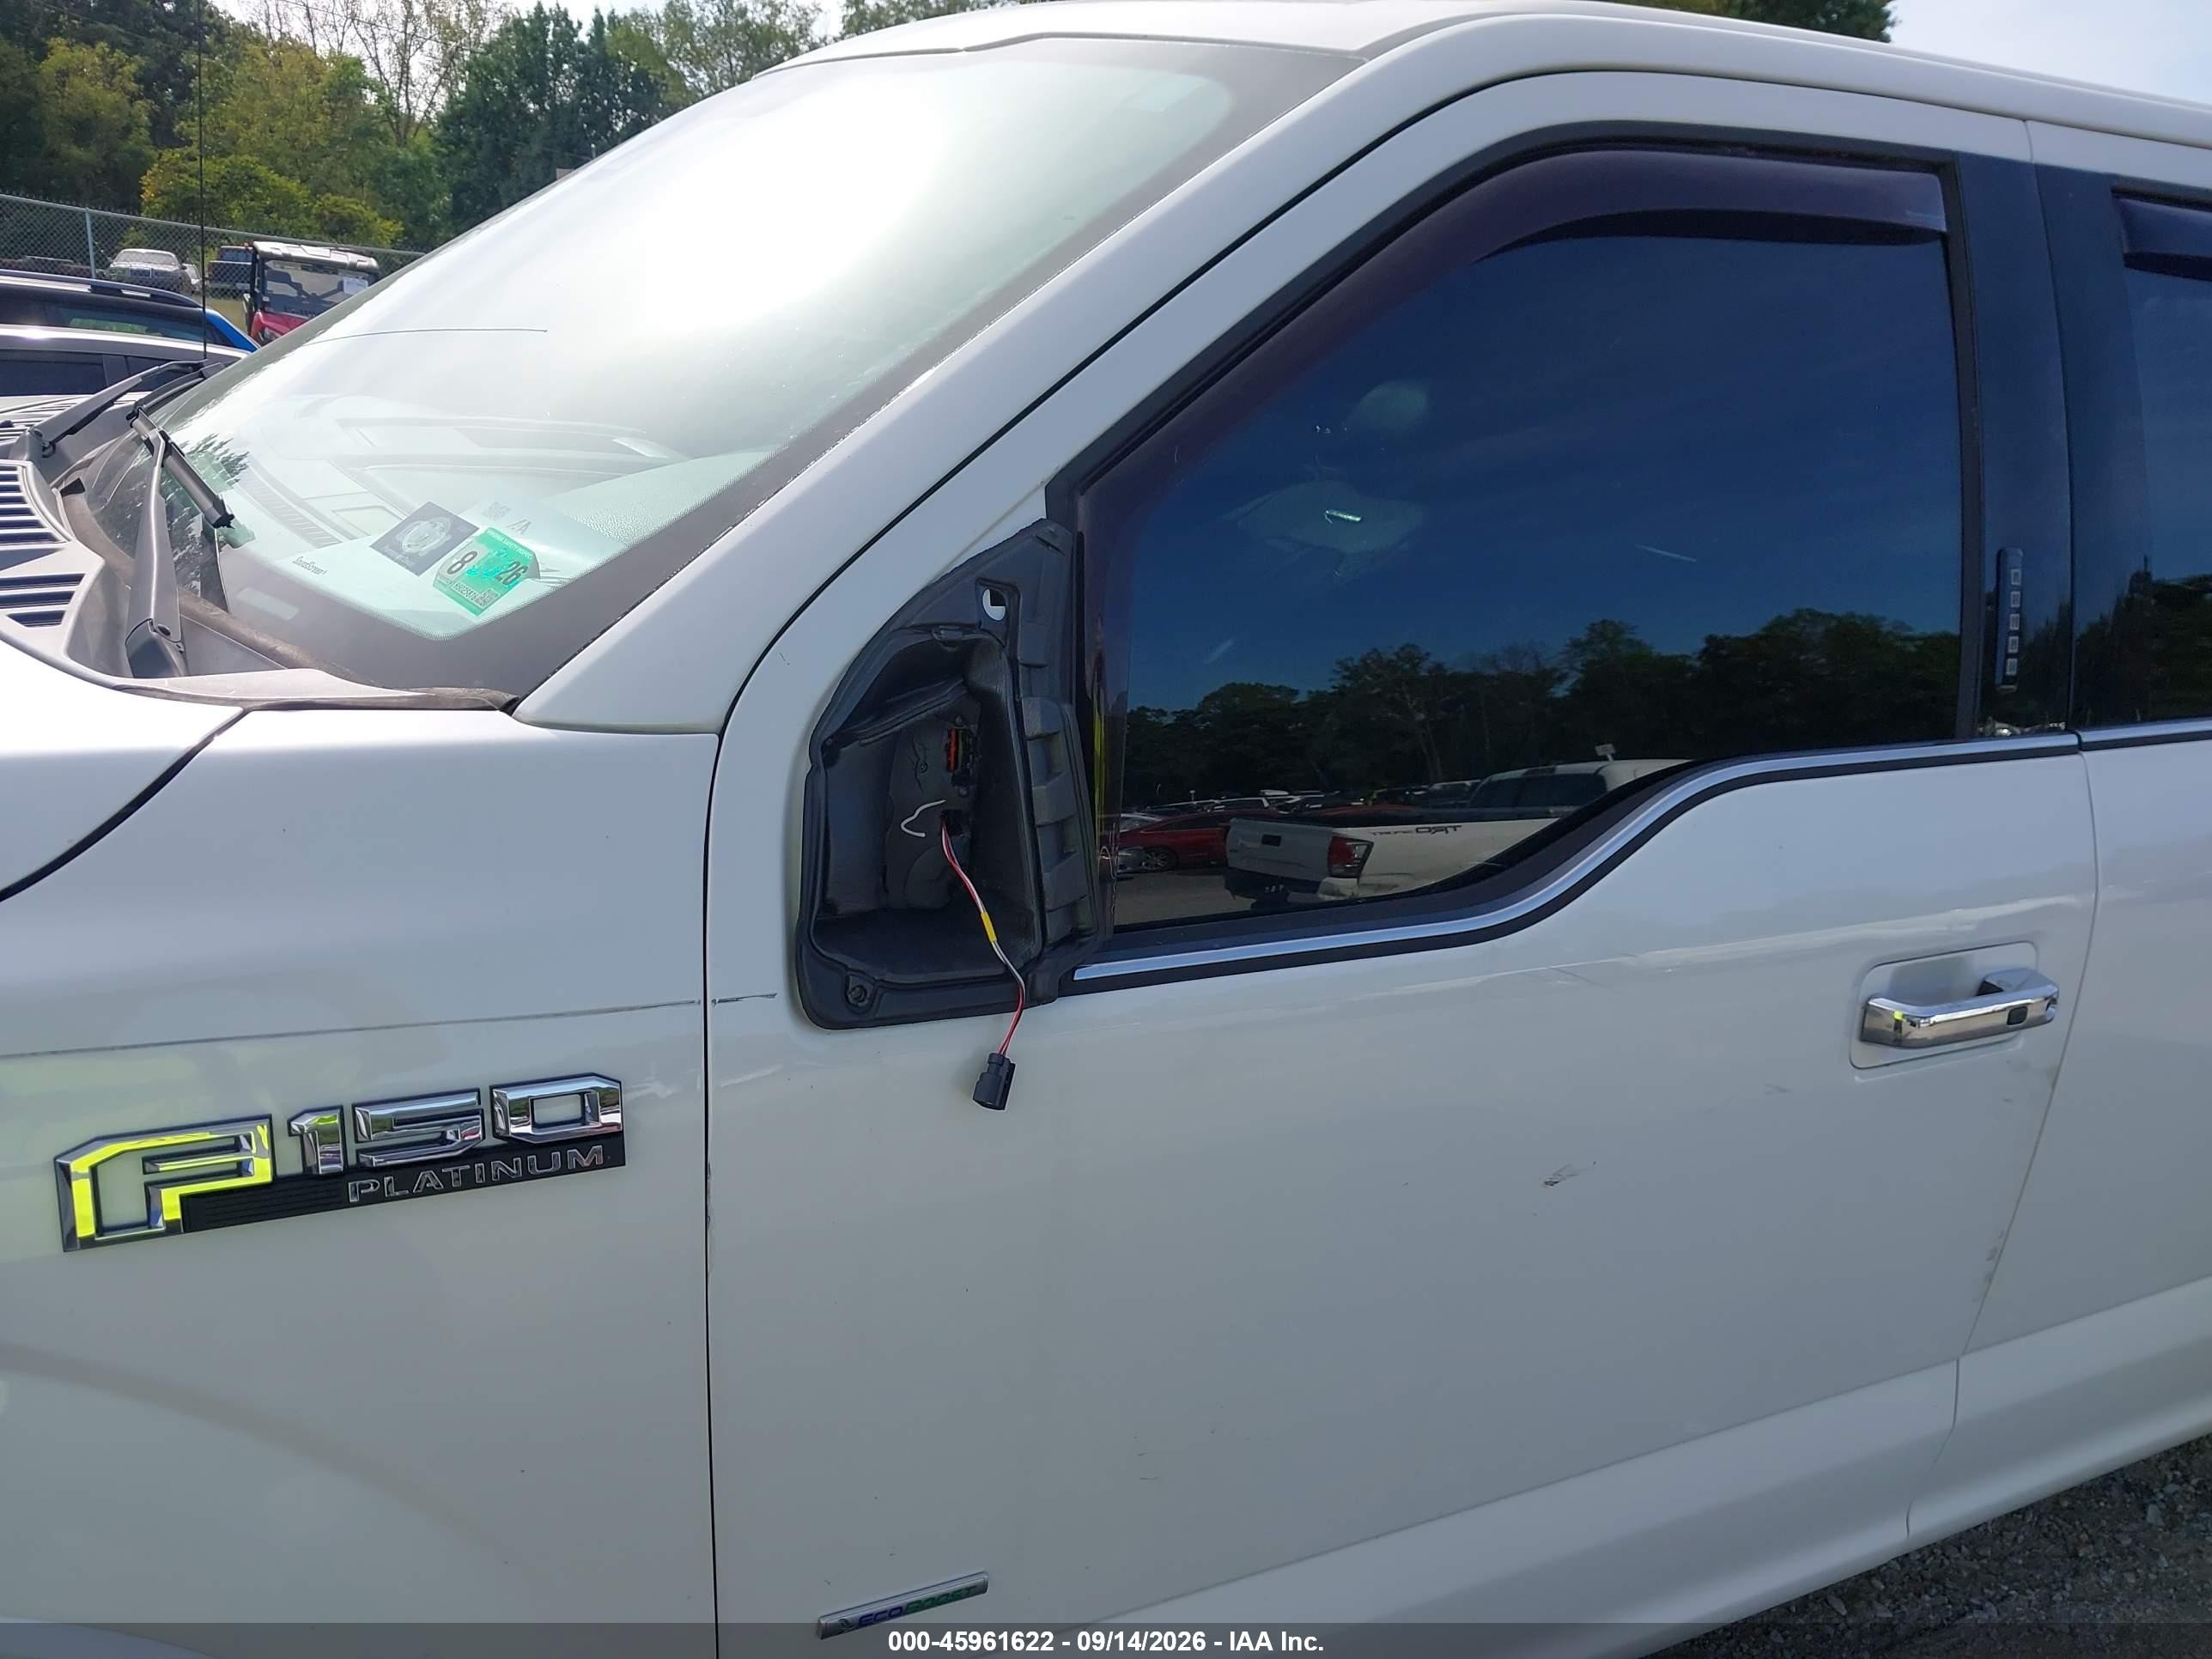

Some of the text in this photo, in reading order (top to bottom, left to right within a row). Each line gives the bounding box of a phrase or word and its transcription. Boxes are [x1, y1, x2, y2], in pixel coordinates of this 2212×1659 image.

[447, 550, 478, 575] 8
[494, 561, 529, 586] 26
[348, 1144, 607, 1204] PLATINUM
